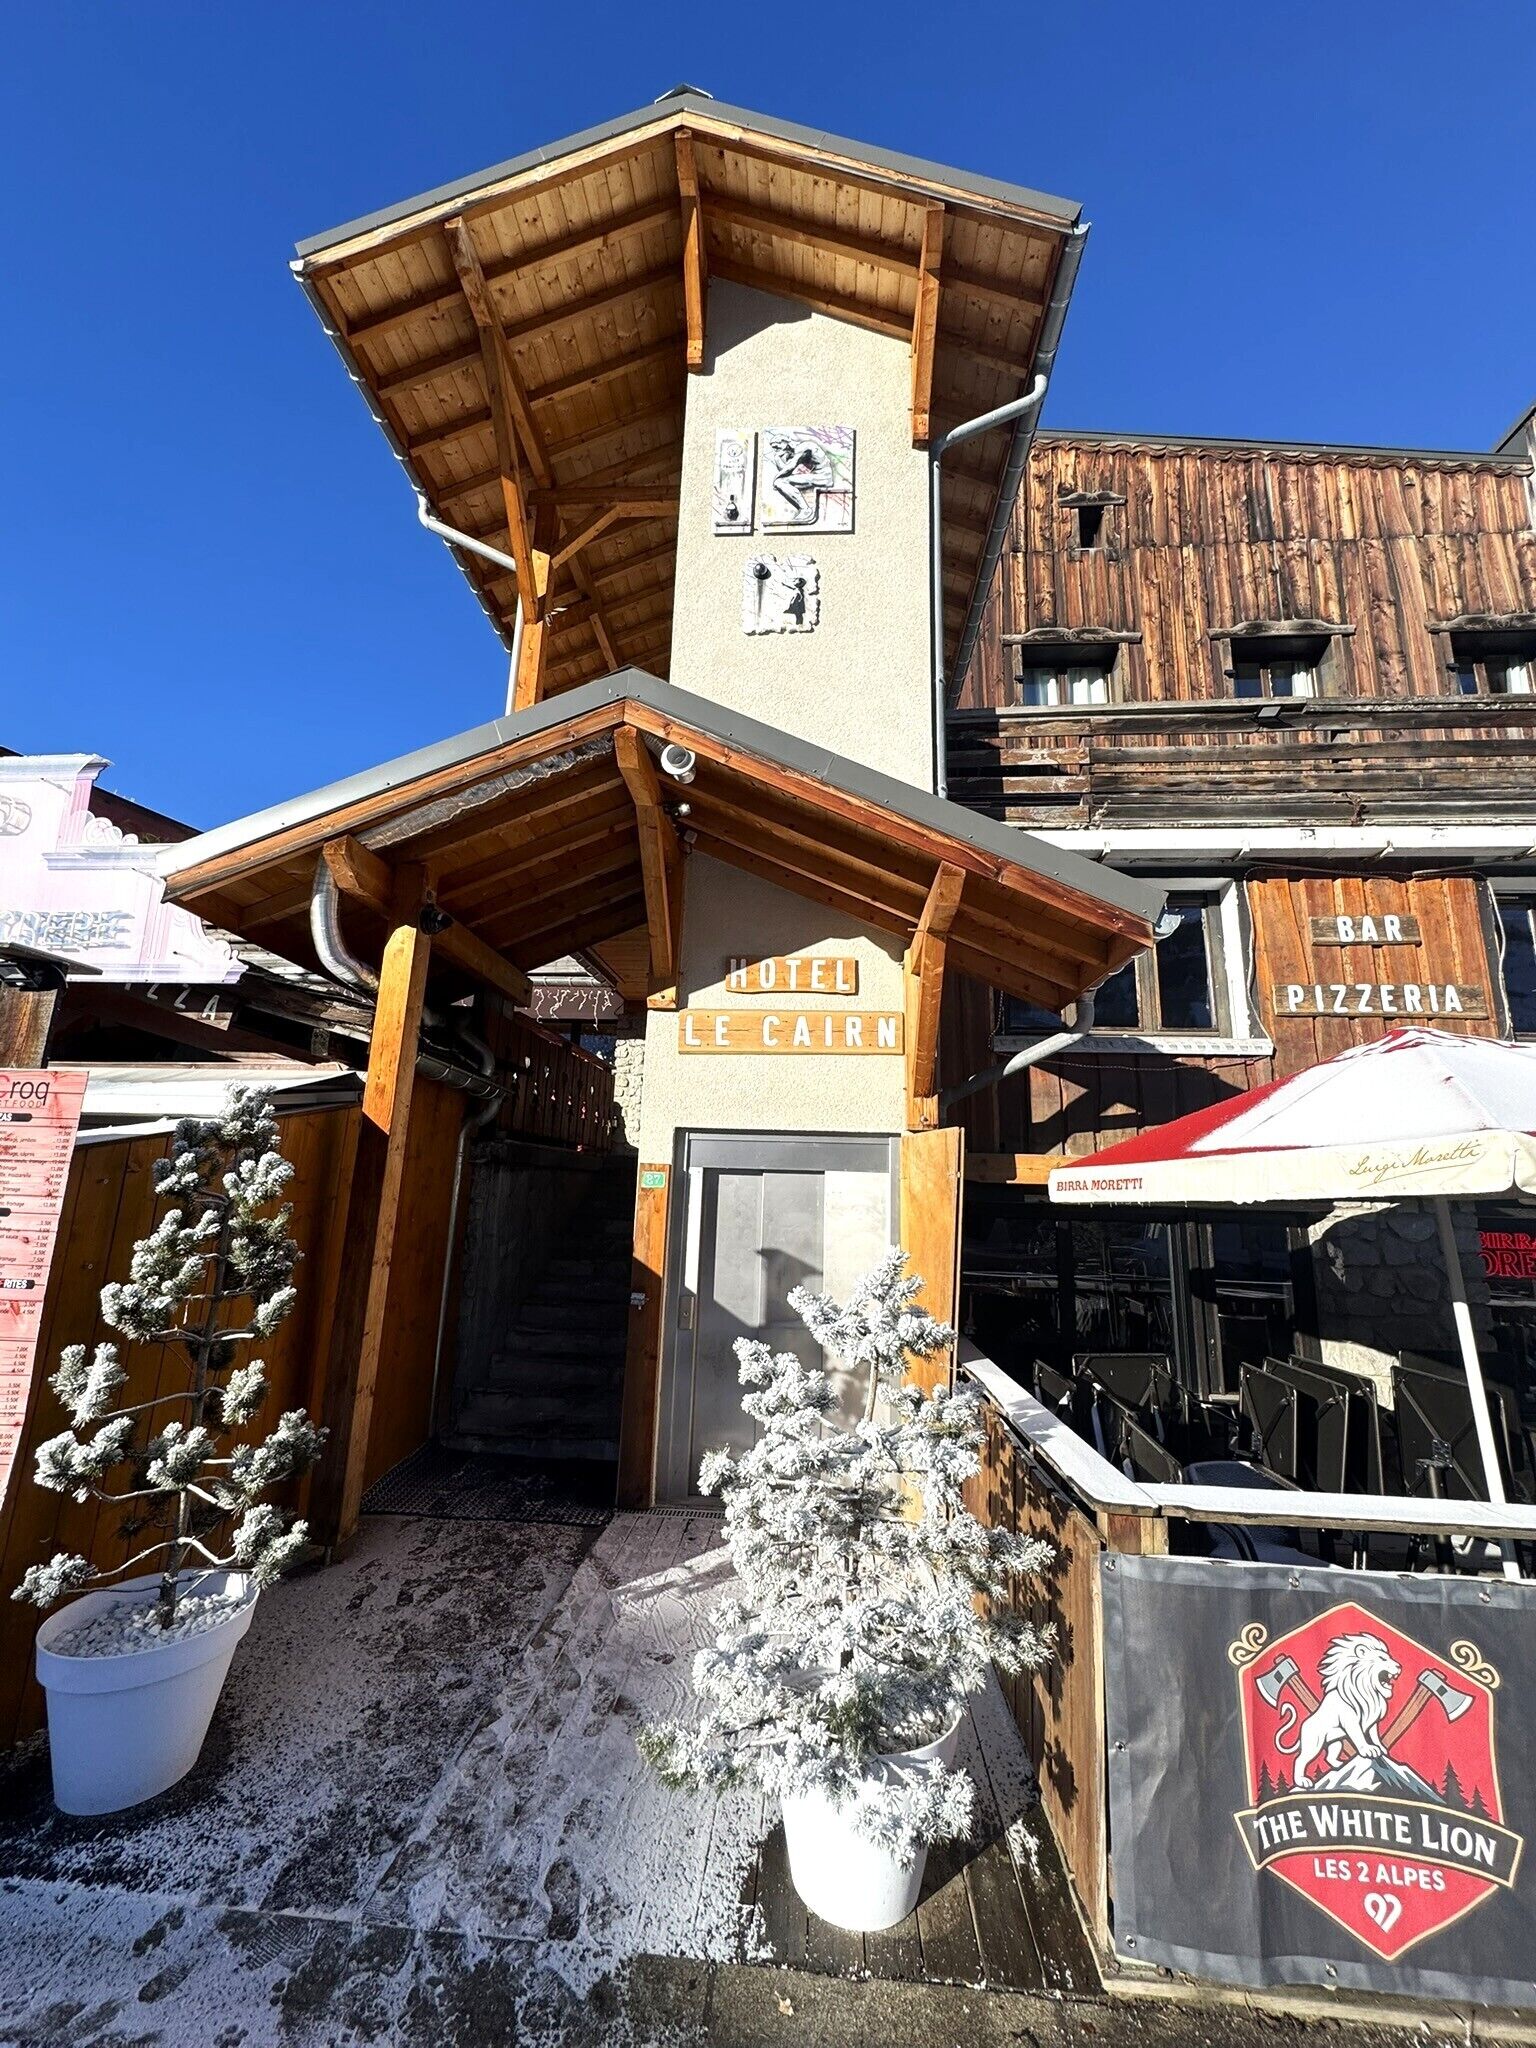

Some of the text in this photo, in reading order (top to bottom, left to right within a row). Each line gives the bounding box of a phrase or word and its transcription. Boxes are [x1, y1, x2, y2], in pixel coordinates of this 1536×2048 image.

[1336, 915, 1404, 942] BAR
[730, 958, 850, 991] HOTEL
[1286, 984, 1464, 1013] PIZZERIA
[685, 1014, 896, 1048] LE CAIRN
[13, 1100, 42, 1108] FOOD
[1349, 1139, 1482, 1177] Luigi Moretti
[1056, 1177, 1143, 1192] BIRRA MORETTI
[1253, 1804, 1497, 1867] THE WHITE LION
[1313, 1857, 1447, 1892] LES 2 ALPES
